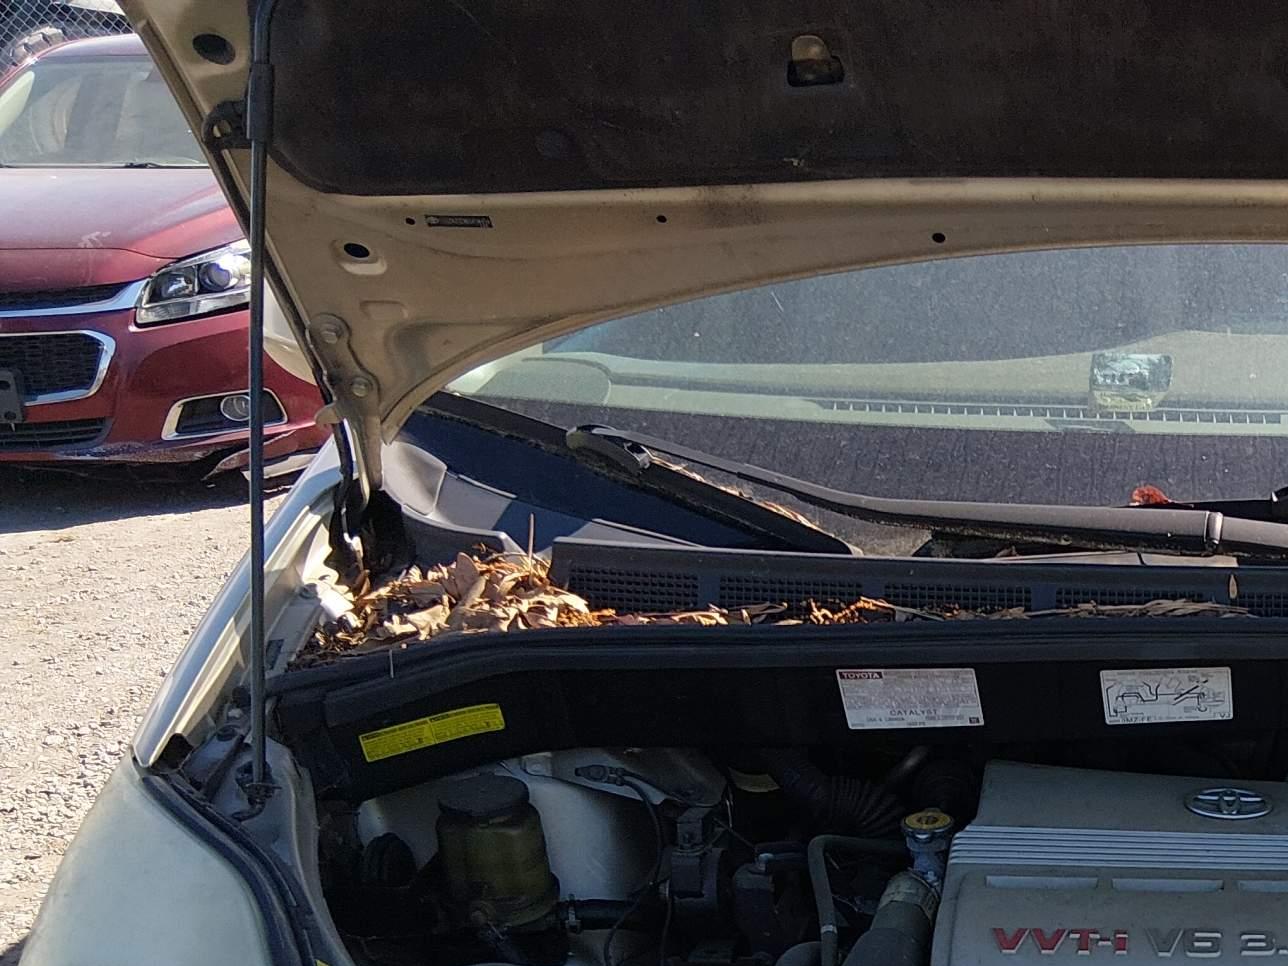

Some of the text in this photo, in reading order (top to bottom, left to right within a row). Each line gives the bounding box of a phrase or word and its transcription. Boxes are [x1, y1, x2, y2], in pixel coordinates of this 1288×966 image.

[842, 672, 880, 680] TOYOTA
[889, 708, 938, 717] CATALYST
[1145, 927, 1223, 959] V6
